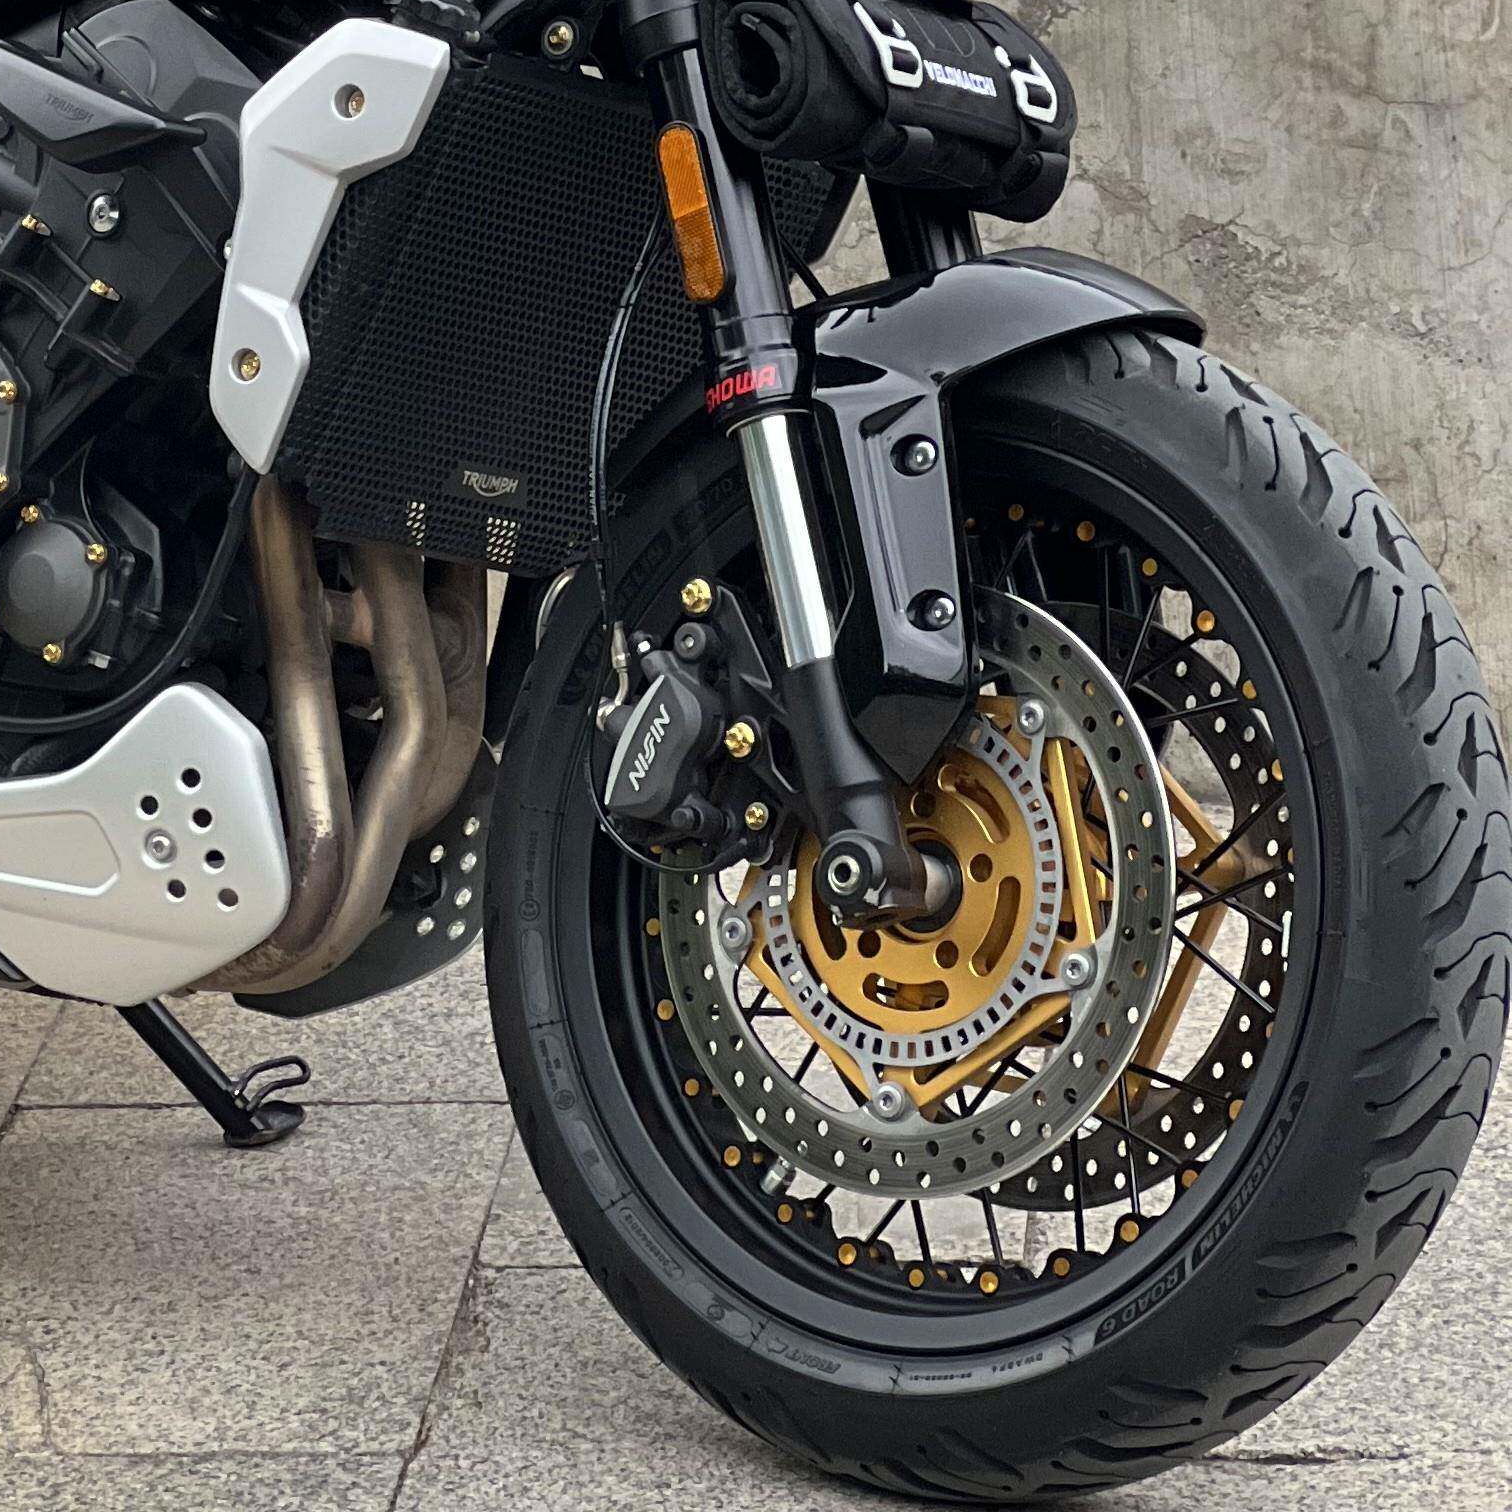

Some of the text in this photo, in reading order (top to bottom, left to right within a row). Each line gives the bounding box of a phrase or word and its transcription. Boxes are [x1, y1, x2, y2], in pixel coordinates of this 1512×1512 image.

[462, 470, 519, 497] TRIUMPH
[1198, 1125, 1286, 1254] MICHELIN
[1122, 1266, 1179, 1323] ROAD
